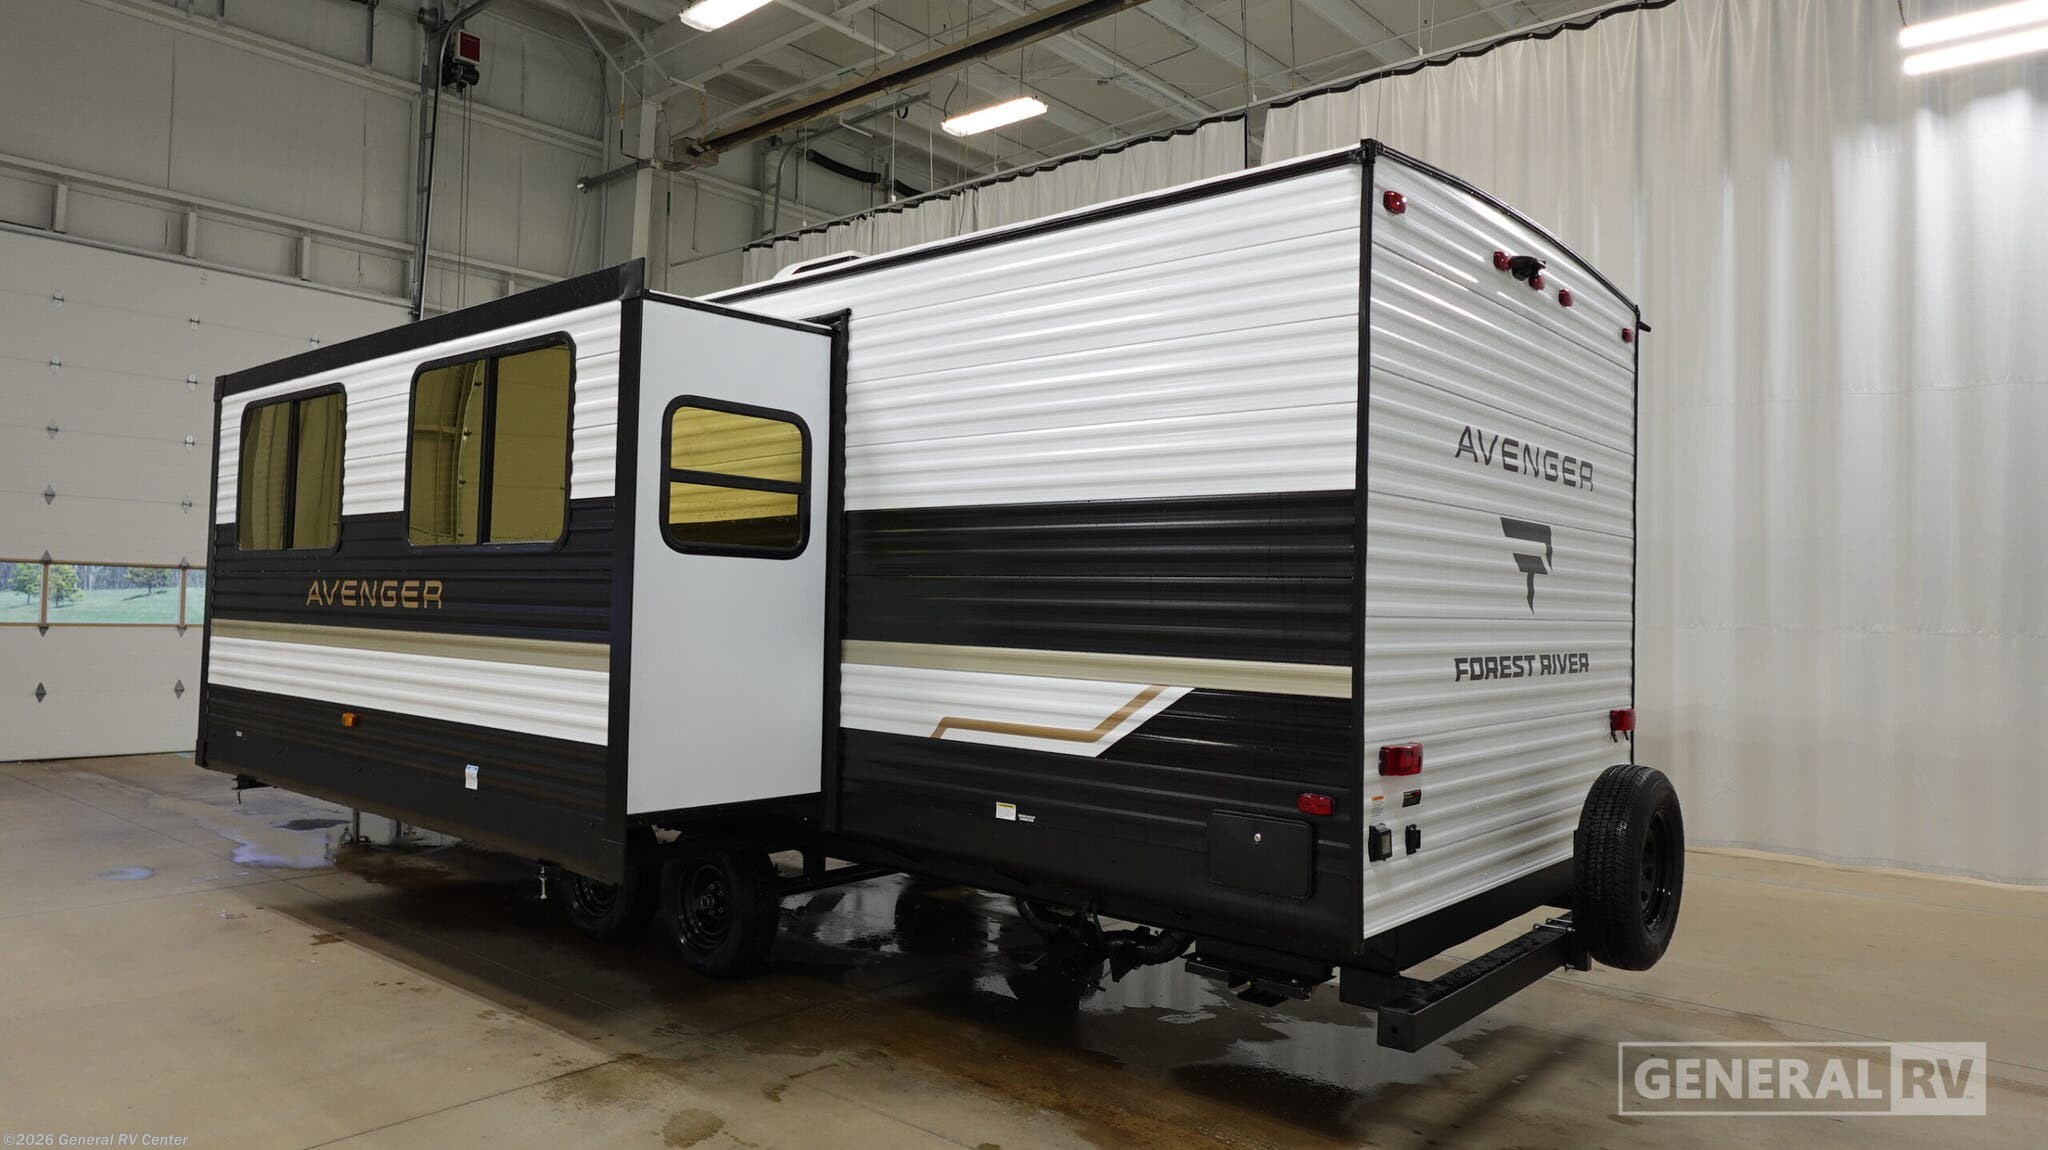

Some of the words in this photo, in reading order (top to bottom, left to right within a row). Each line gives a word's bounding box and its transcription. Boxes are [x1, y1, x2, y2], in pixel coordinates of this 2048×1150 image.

[1455, 425, 1593, 491] AVENGER
[306, 580, 443, 609] AVENGER
[1454, 655, 1535, 682] FOREST
[1539, 653, 1589, 675] RIVER
